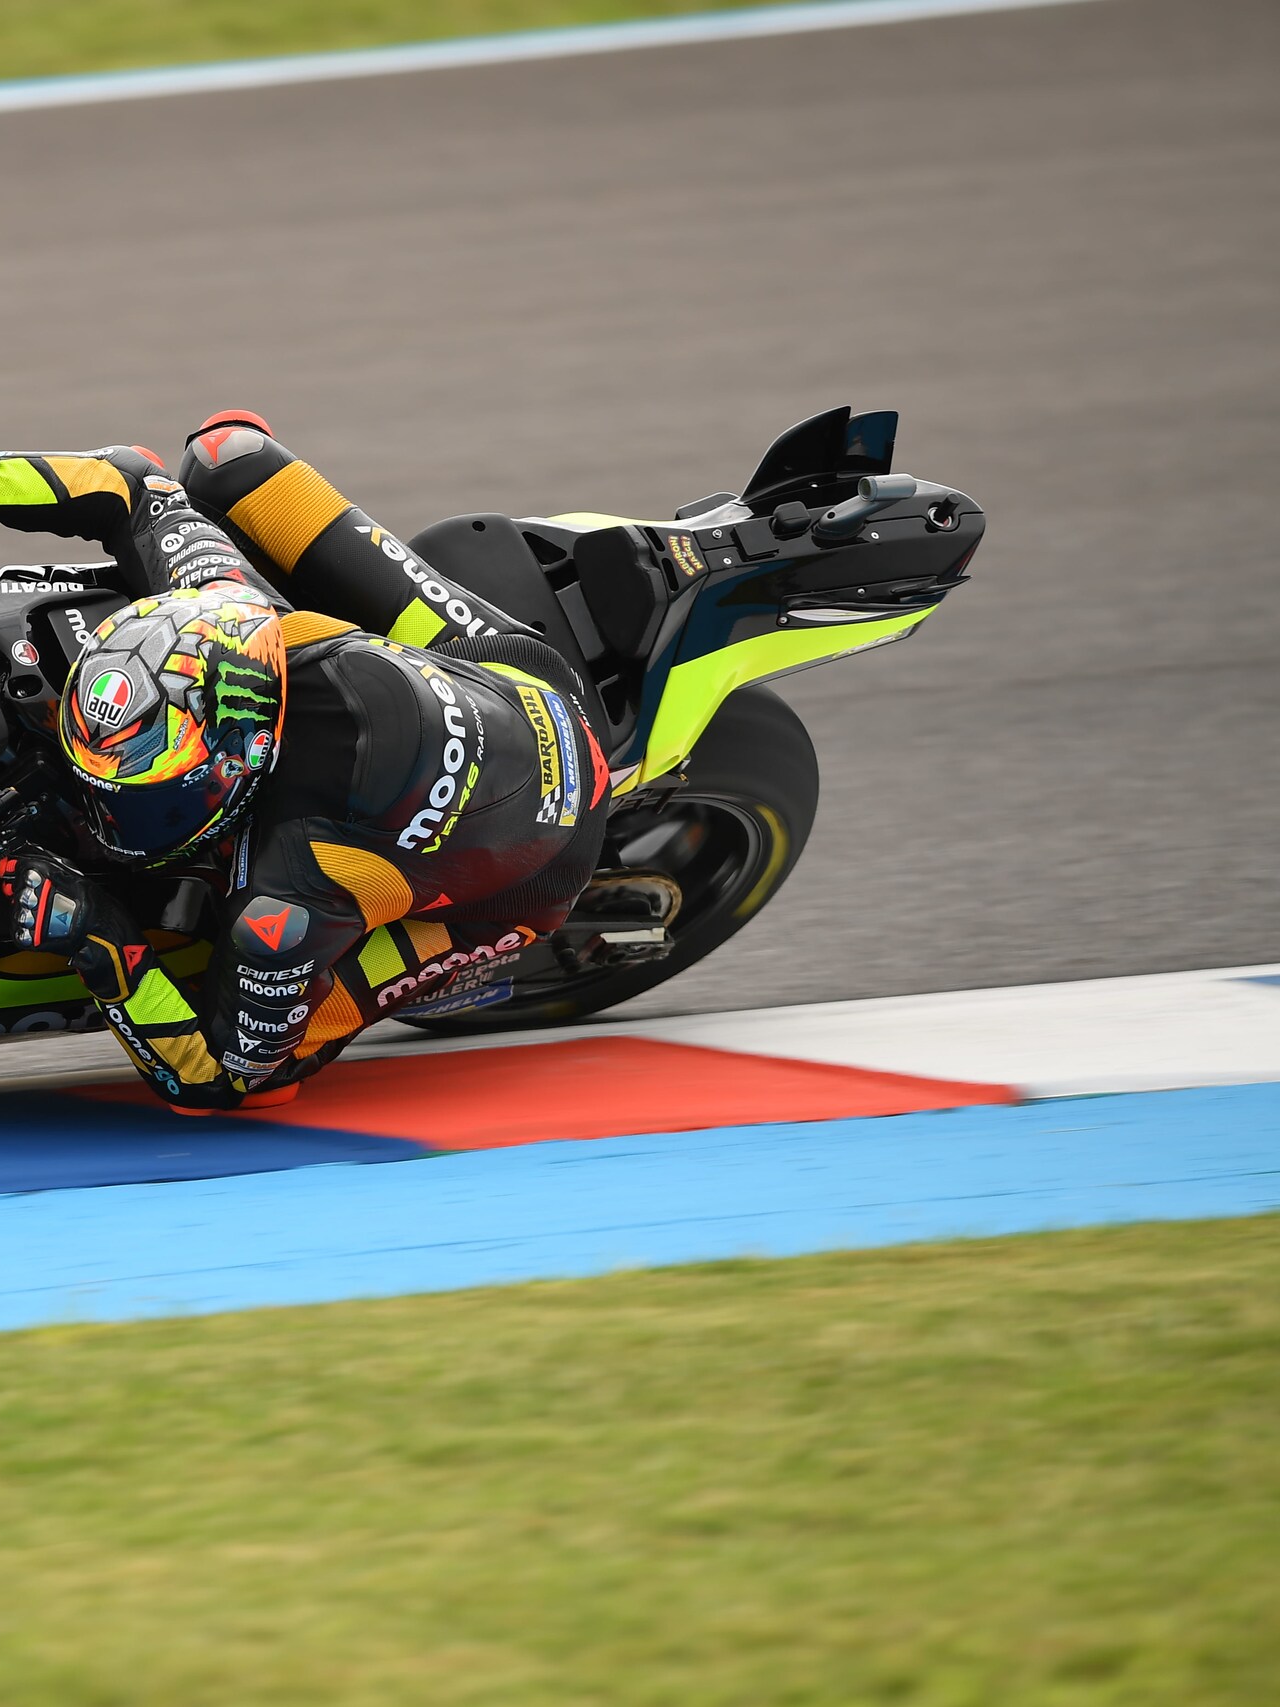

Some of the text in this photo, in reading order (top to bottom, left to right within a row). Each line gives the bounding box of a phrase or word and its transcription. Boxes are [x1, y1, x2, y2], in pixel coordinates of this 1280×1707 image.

[1, 582, 84, 593] DUCATI
[88, 696, 123, 726] agv
[523, 691, 556, 786] BARDAHL
[550, 699, 577, 786] MICHELIN
[72, 764, 122, 793] mooney
[236, 959, 315, 981] DAINESE
[239, 977, 309, 997] mooney
[238, 1010, 289, 1033] flyme
